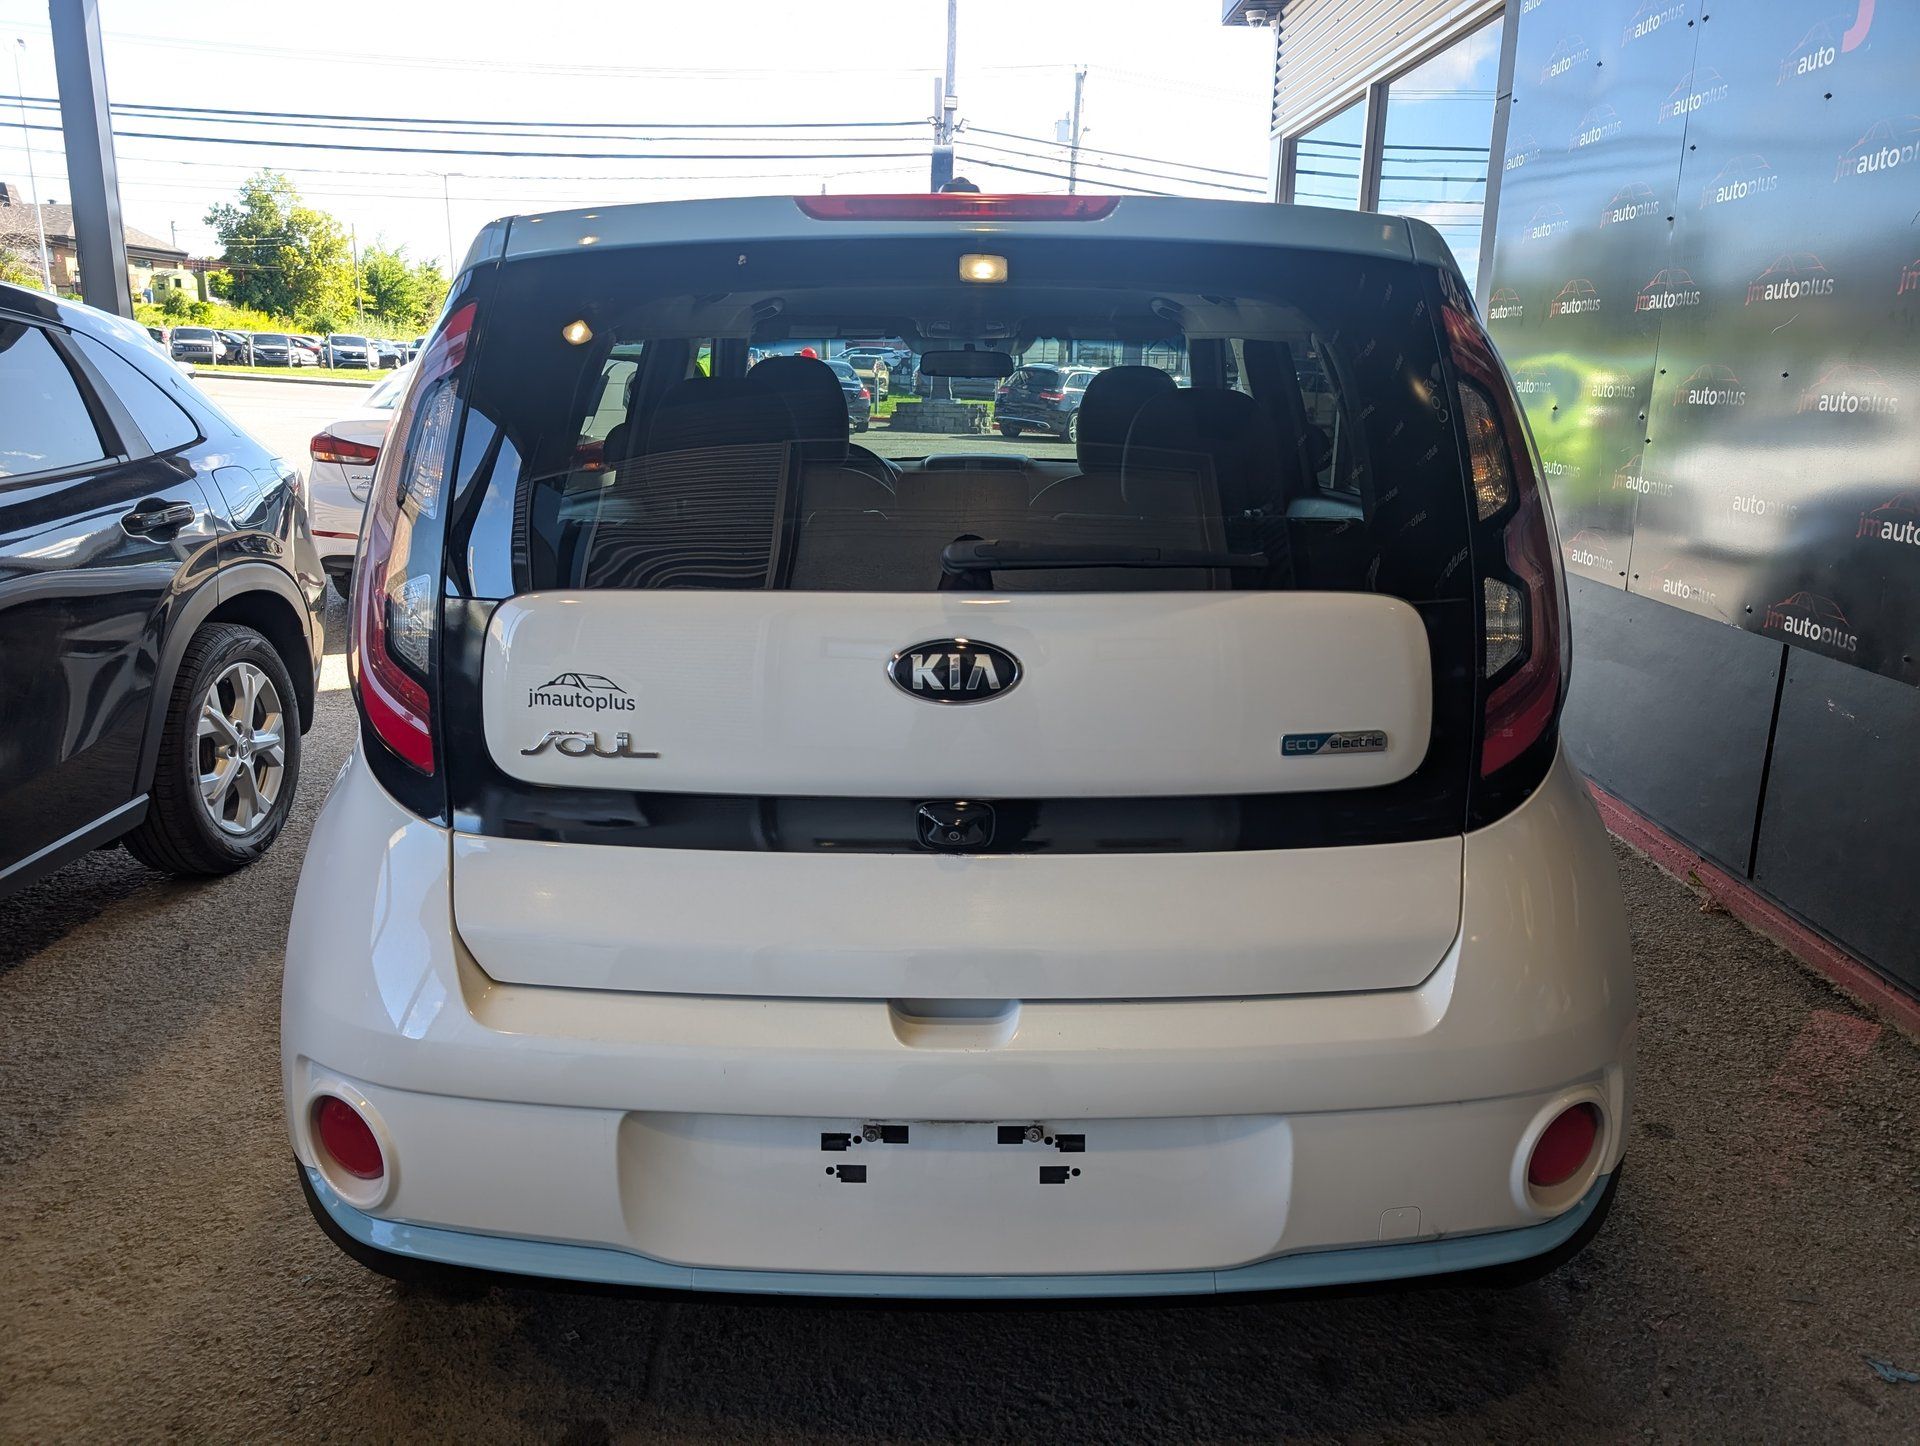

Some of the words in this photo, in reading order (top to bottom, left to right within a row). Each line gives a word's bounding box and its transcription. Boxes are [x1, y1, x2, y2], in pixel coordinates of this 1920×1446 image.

[1634, 288, 1700, 314] jmautoplus
[1745, 278, 1834, 306] jmautoplus
[1550, 297, 1600, 318] jmautoplus
[1673, 385, 1746, 407] jmautoplus
[1764, 605, 1858, 651] jmautoplus
[911, 653, 1000, 690] KIA
[528, 689, 635, 712] jmautoplus
[1286, 739, 1319, 750] ECO
